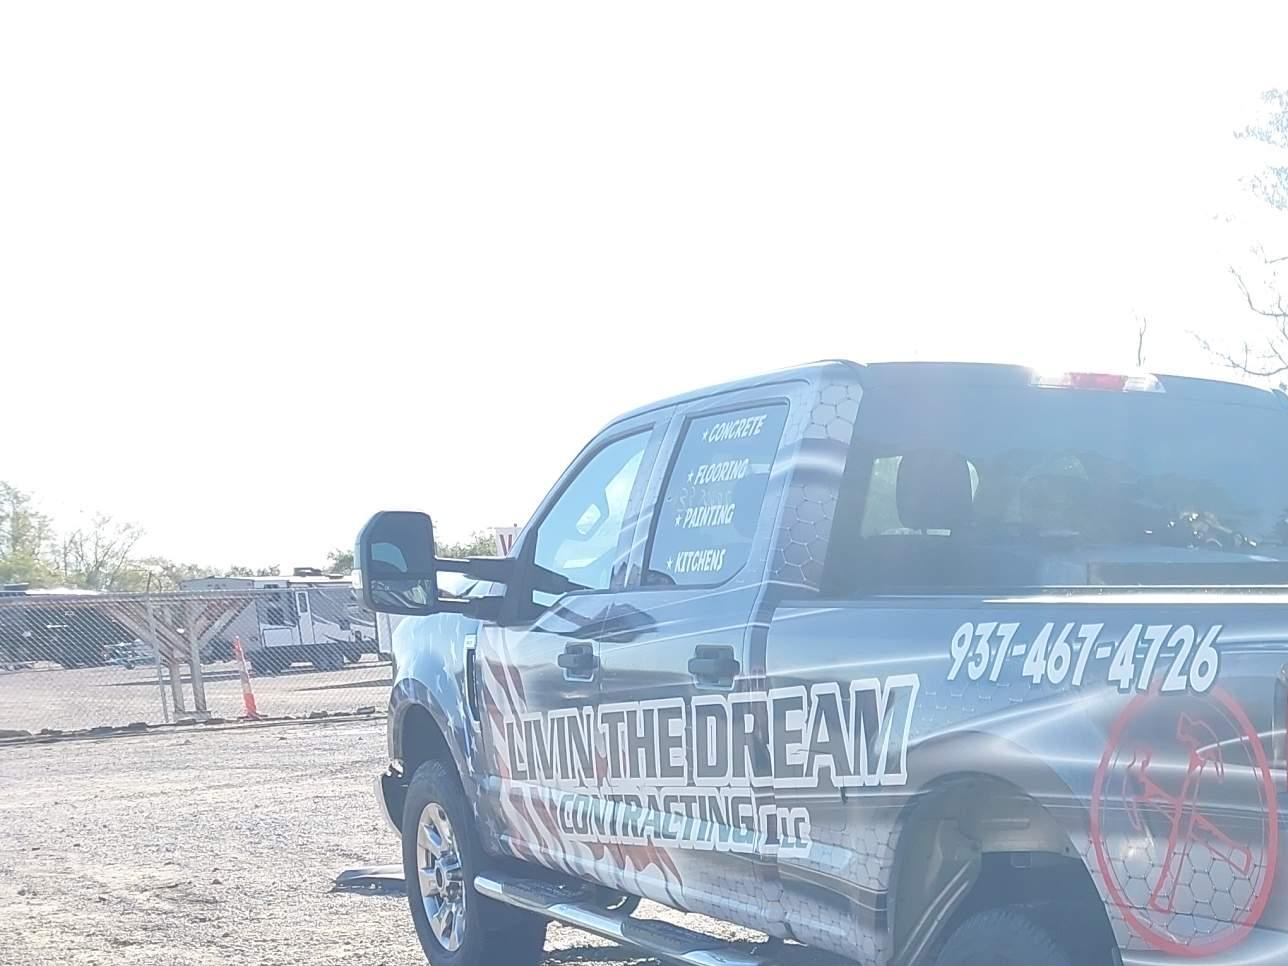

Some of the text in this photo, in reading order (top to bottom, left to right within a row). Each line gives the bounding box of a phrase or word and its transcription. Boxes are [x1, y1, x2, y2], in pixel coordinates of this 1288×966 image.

[708, 414, 767, 443] CONCRETE
[693, 458, 749, 486] FLOORING
[682, 503, 736, 529] PAINTING
[674, 549, 726, 573] KITCHENS
[946, 622, 1223, 694] 937-467-4726
[503, 674, 919, 788] LIVIN THE DREAM
[556, 788, 758, 853] CONTRACTING
